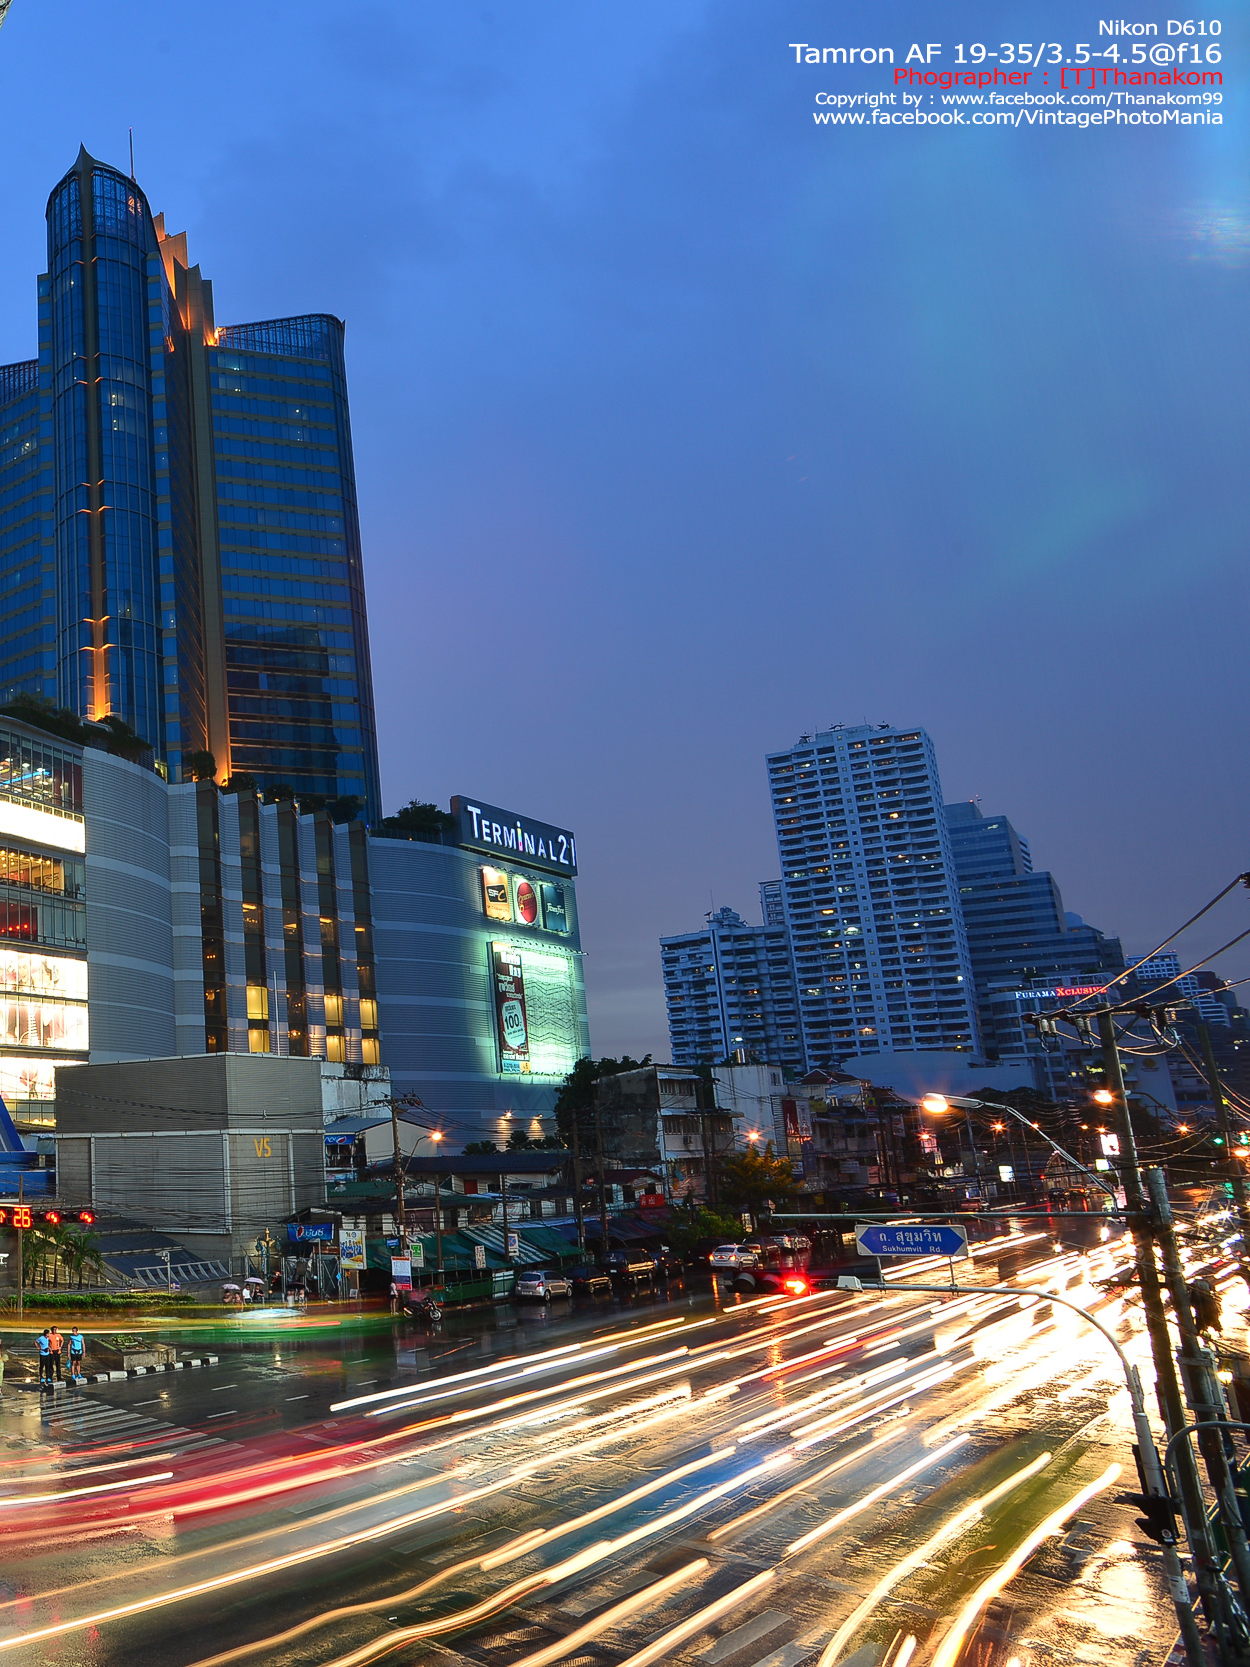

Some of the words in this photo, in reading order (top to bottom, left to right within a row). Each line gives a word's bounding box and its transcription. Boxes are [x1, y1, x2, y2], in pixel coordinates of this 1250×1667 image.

[253, 1136, 272, 1158] VS
[13, 1207, 31, 1228] 26
[879, 1232, 891, 1242] ถ.
[895, 1228, 942, 1245] สุขุมวิท
[882, 1245, 923, 1253] Sukhumvit
[929, 1245, 944, 1253] Rd.
